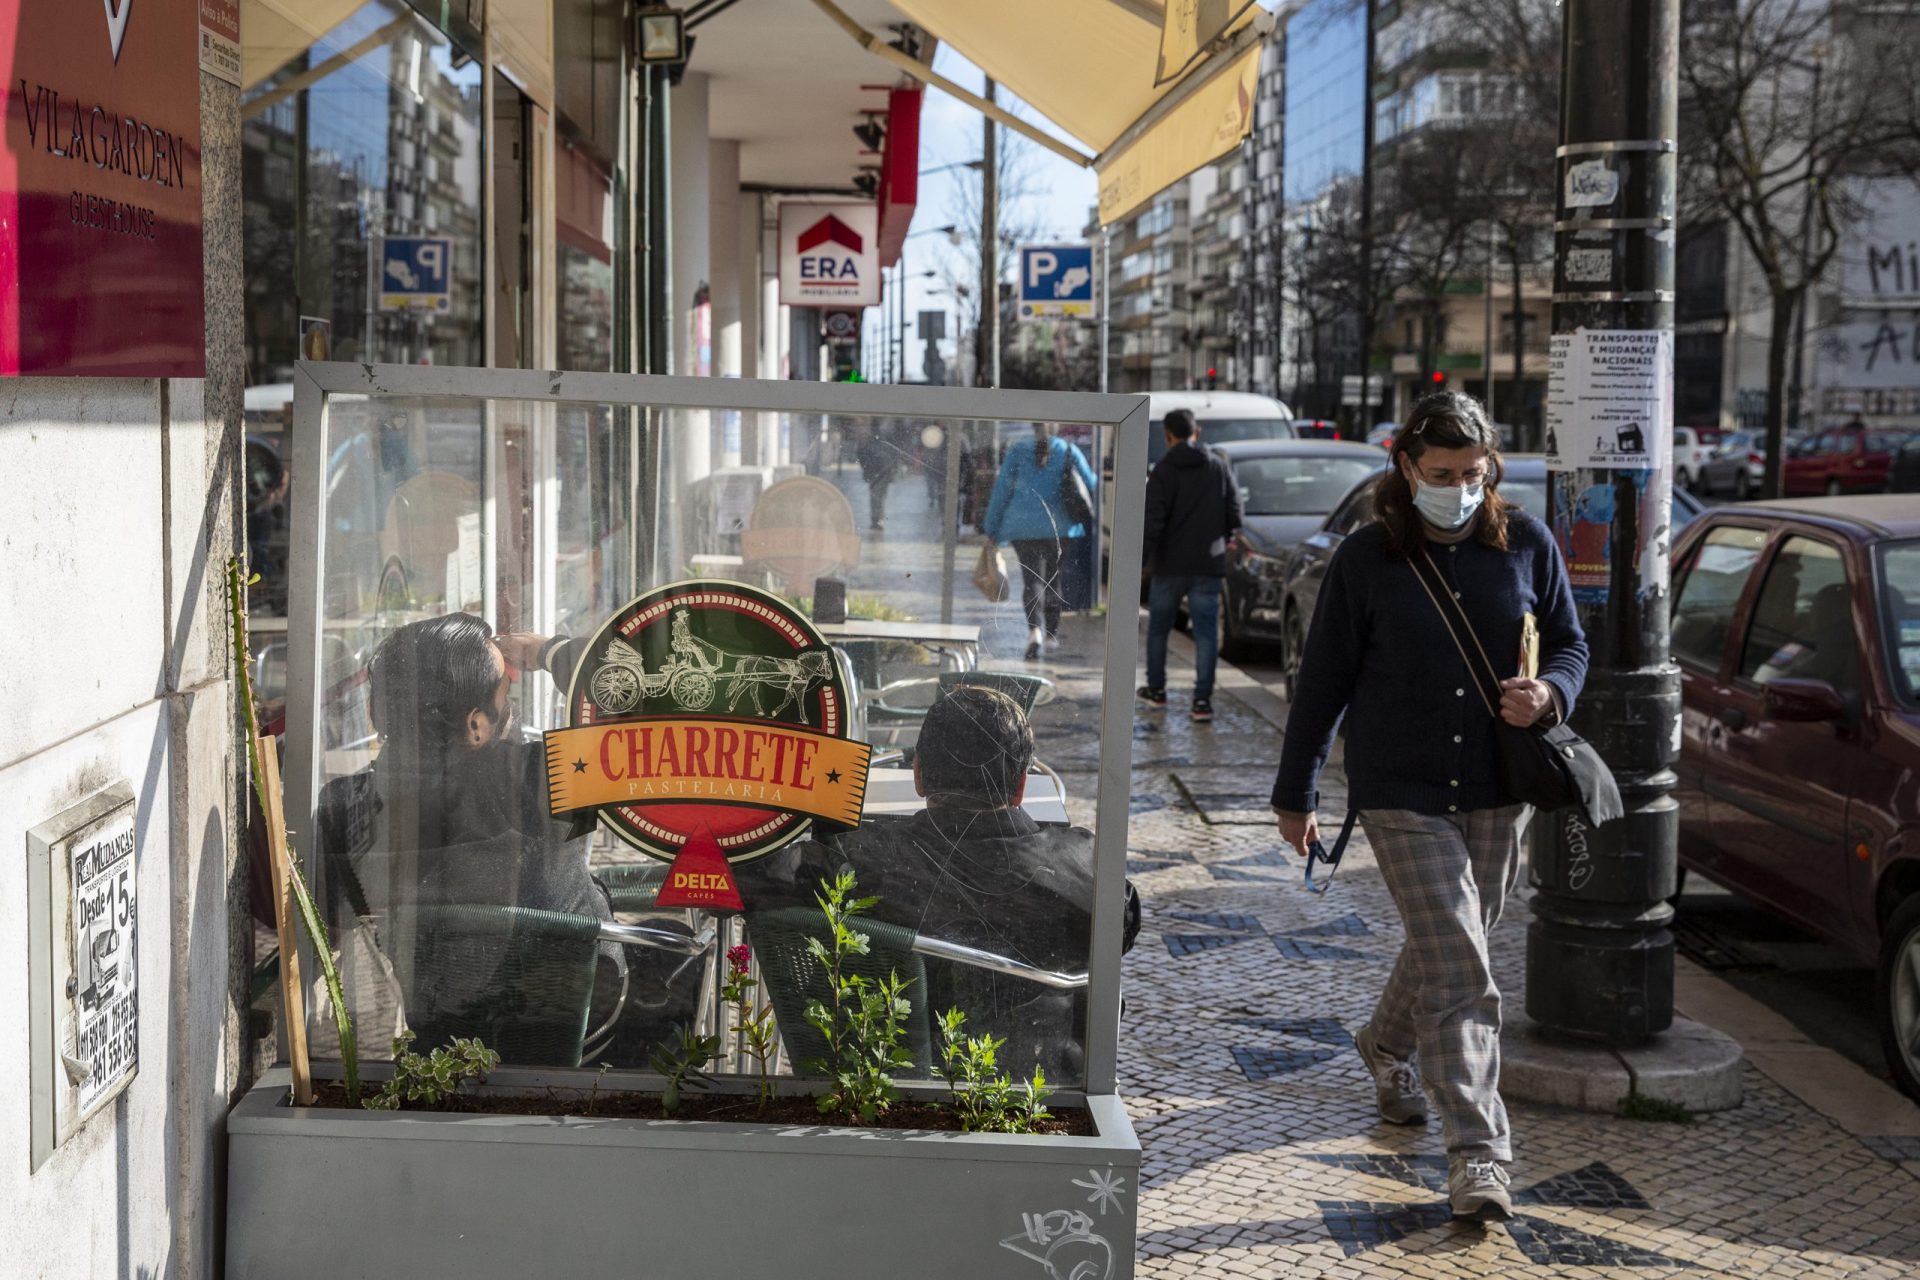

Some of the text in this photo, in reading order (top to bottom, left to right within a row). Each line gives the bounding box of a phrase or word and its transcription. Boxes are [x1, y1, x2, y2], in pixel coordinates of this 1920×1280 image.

[20, 78, 183, 190] VILAGARDEN
[69, 190, 156, 240] GUESTHOUSE
[800, 257, 858, 279] ERA
[1029, 251, 1058, 288] P
[1586, 334, 1659, 344] TRANSPORTES
[1589, 346, 1656, 356] E MUDANÇAS
[1592, 357, 1653, 365] NACIONAIS
[600, 726, 819, 792] CHARRETE
[629, 780, 782, 802] PASTELARIA
[675, 873, 729, 889] DELTA
[80, 886, 106, 930] Desde
[92, 1046, 107, 1089] 961
[108, 1033, 122, 1075] 556
